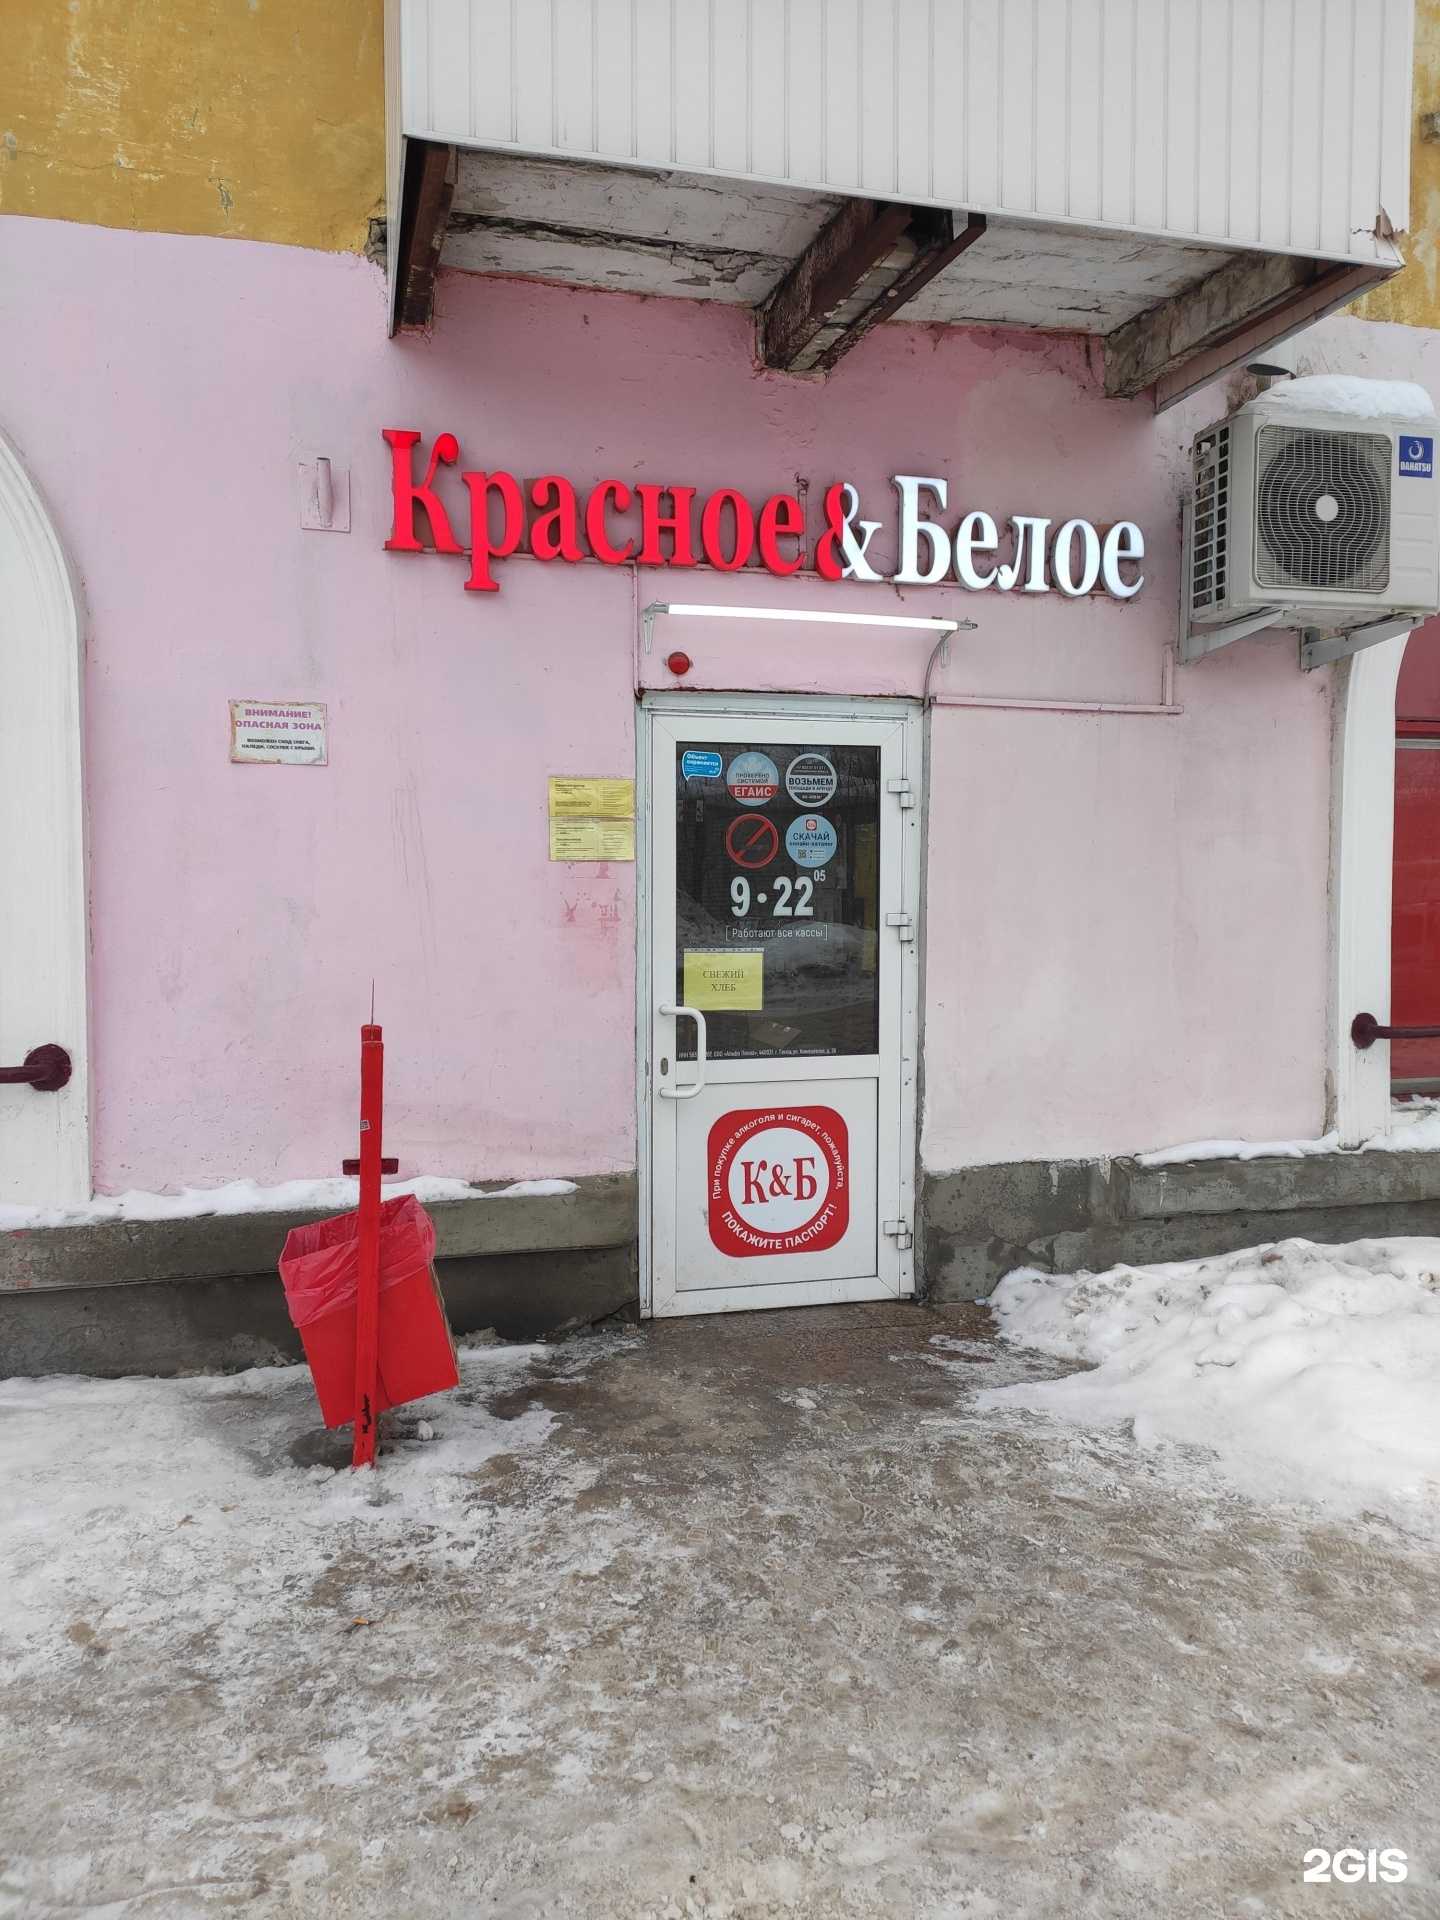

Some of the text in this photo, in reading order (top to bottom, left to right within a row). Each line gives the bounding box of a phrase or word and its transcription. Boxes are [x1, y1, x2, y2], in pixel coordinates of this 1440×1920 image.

[244, 708, 312, 719] ВНИМАНИЕ!
[235, 720, 322, 731] ОПАСНАЯ ЗОНА
[788, 777, 834, 786] ВОЗЬМЕМ
[734, 786, 772, 797] ЕГАИС
[792, 831, 830, 841] СКАЧАЙ
[813, 869, 826, 882] 05
[779, 928, 793, 938] все
[702, 968, 744, 979] СВЕЖИЙ
[711, 983, 737, 992] ХЛЕБ
[777, 1113, 784, 1121] и
[735, 1113, 776, 1139] алкоголя
[785, 1113, 822, 1135] сигарет,
[714, 1137, 735, 1178] покупке
[740, 1156, 818, 1205] К&Б
[712, 1179, 721, 1199] При
[721, 1202, 837, 1250] ПОКАЖИТЕ ПАСПОРТ!
